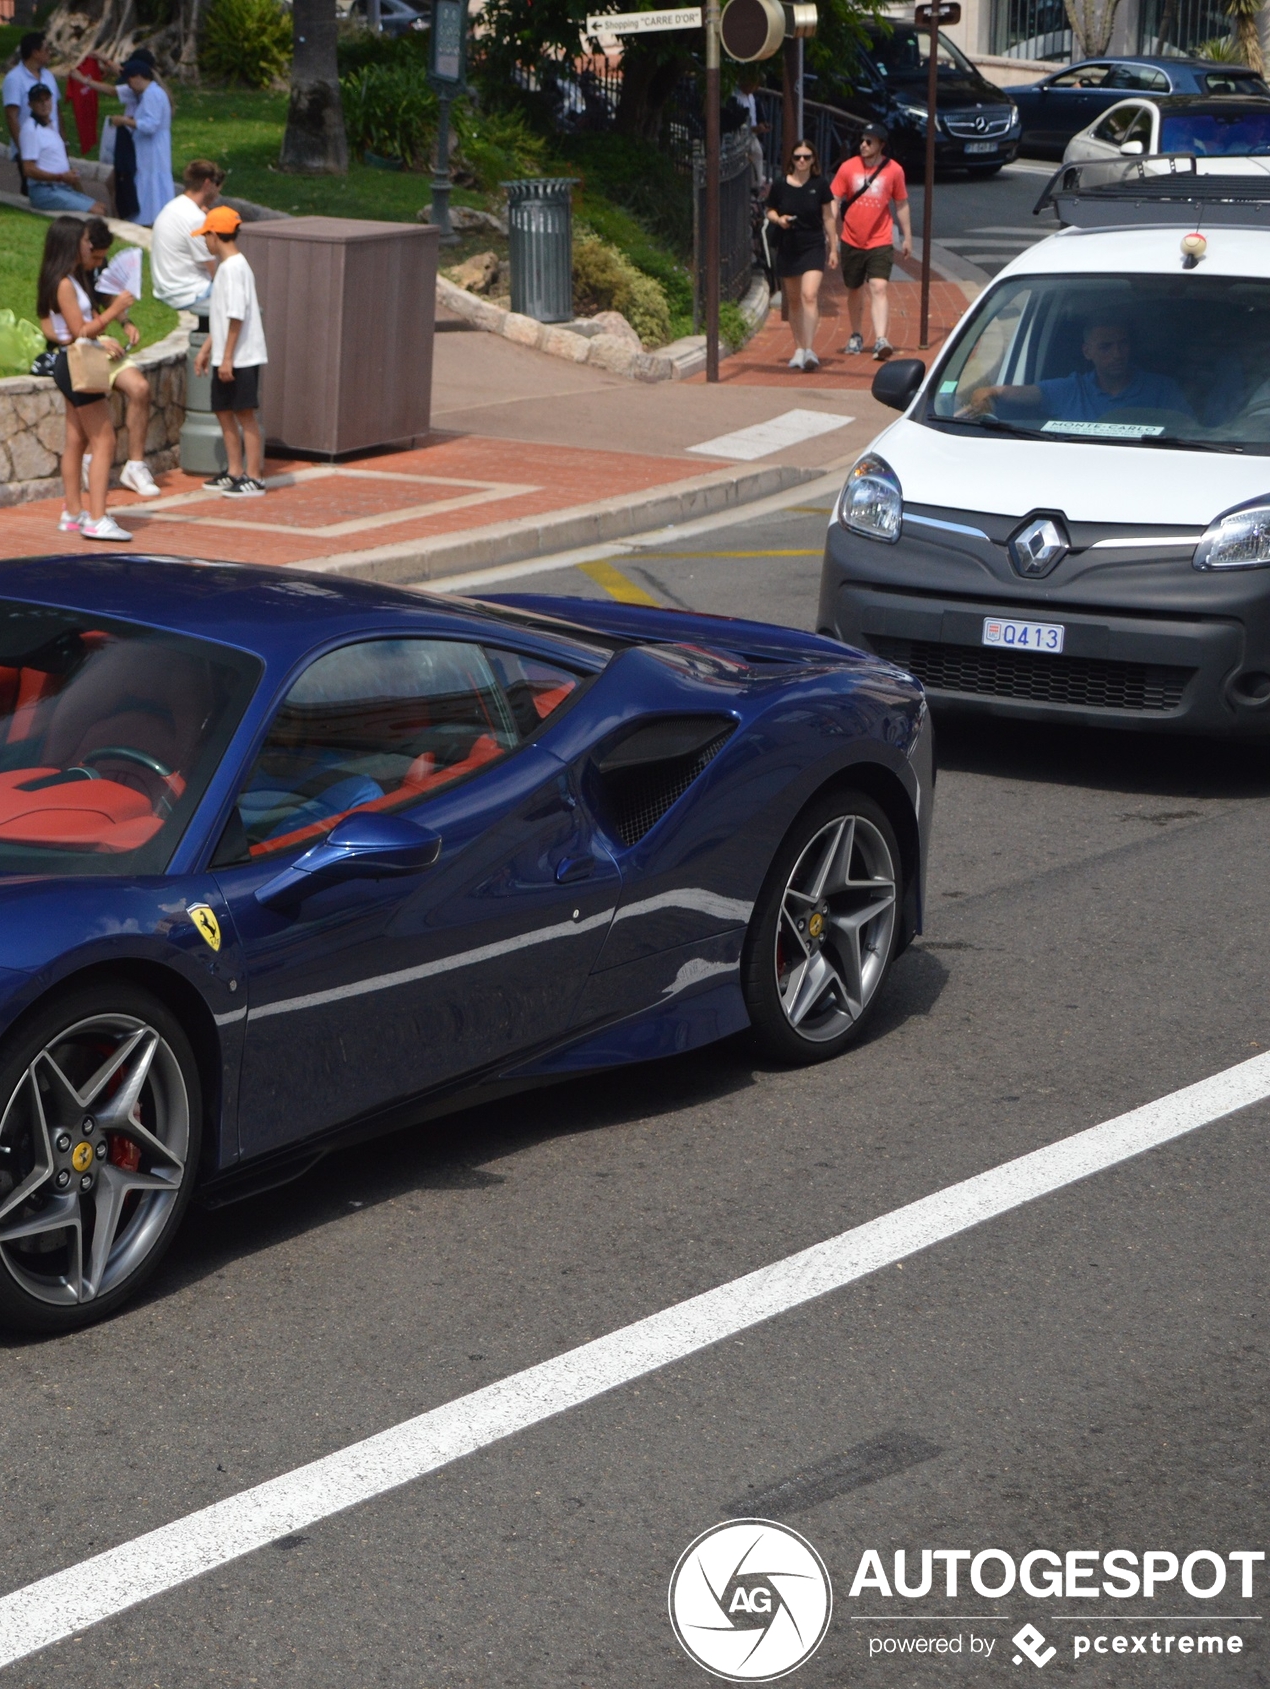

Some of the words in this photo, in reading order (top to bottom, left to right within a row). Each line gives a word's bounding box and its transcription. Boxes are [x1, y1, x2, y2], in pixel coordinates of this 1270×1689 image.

[605, 20, 639, 30] Shopping
[641, 15, 673, 25] "CARRE
[1004, 625, 1058, 648] Q413
